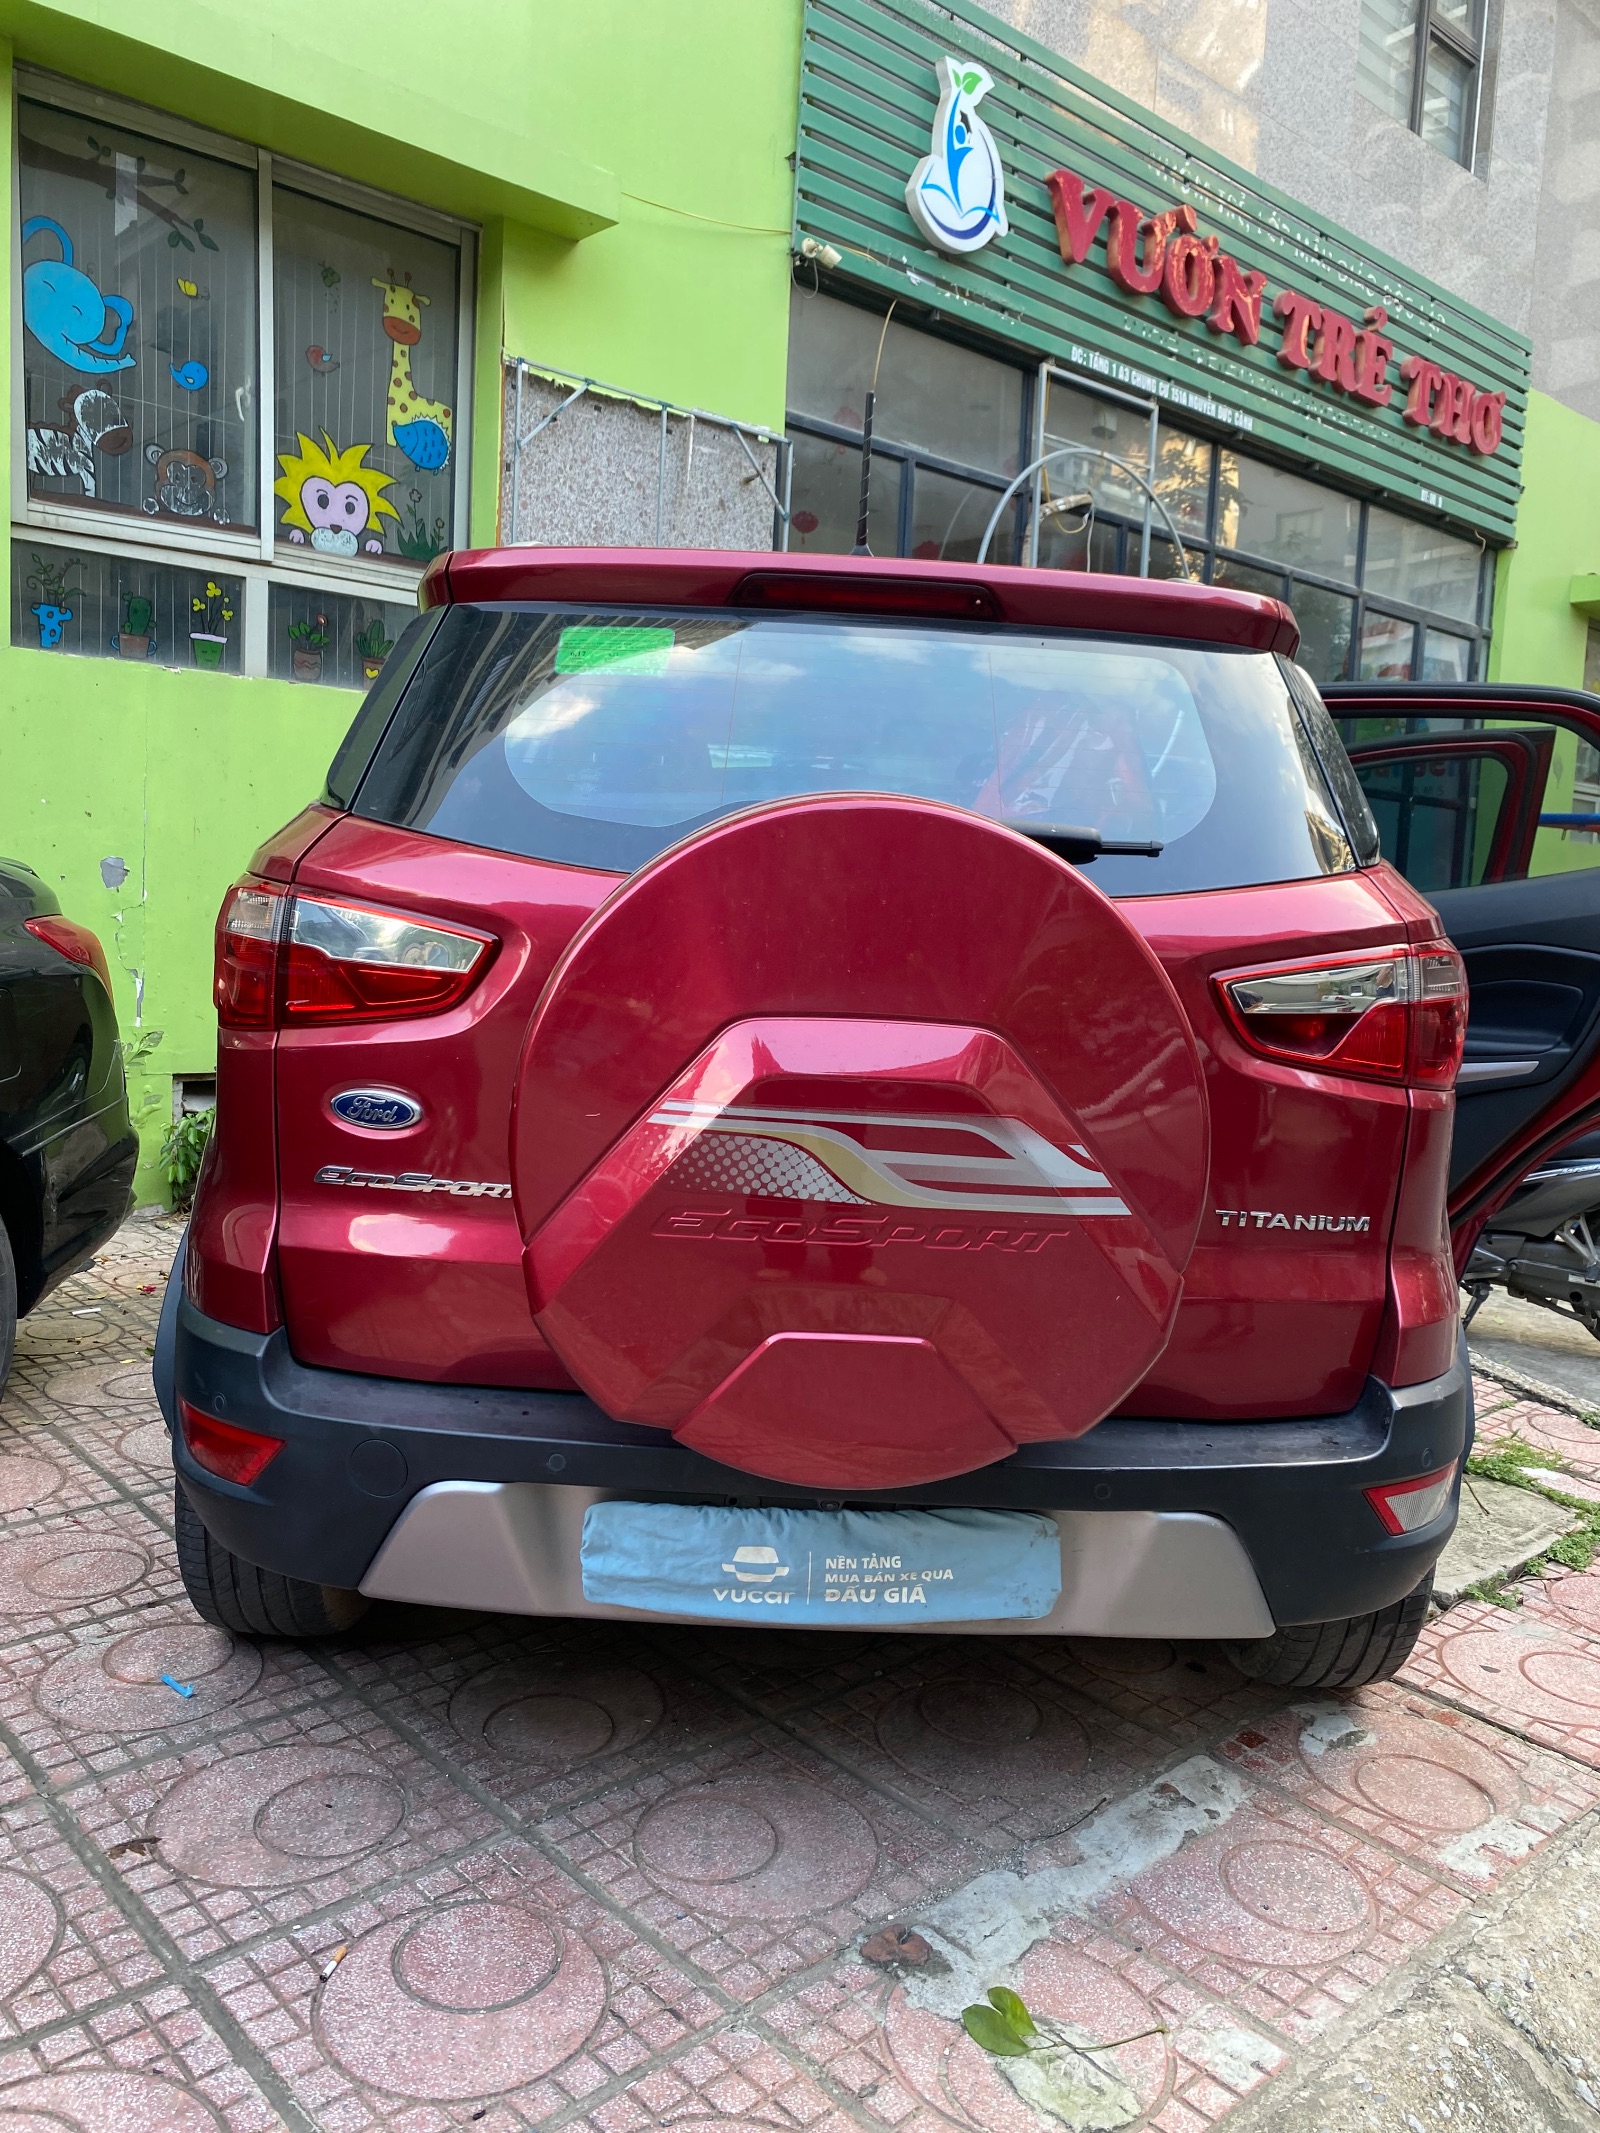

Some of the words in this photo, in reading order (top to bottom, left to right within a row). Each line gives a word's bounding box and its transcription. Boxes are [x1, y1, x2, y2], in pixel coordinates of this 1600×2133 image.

[1118, 367, 1130, 382] A3
[1131, 370, 1157, 393] CHUNG
[1273, 290, 1394, 407] TRẺ
[1400, 355, 1506, 455] THƠ
[347, 1096, 398, 1123] Ford
[1215, 1209, 1371, 1232] TITANIUM
[825, 1555, 857, 1569] NỀN
[861, 1553, 901, 1569] TẢNG
[825, 1573, 859, 1583] MUA
[864, 1572, 896, 1583] BÁN
[899, 1572, 917, 1582] XE
[921, 1569, 954, 1581] QUA
[712, 1588, 796, 1604] vucar
[824, 1585, 876, 1603] ĐẤU
[883, 1584, 927, 1604] GIÁ
